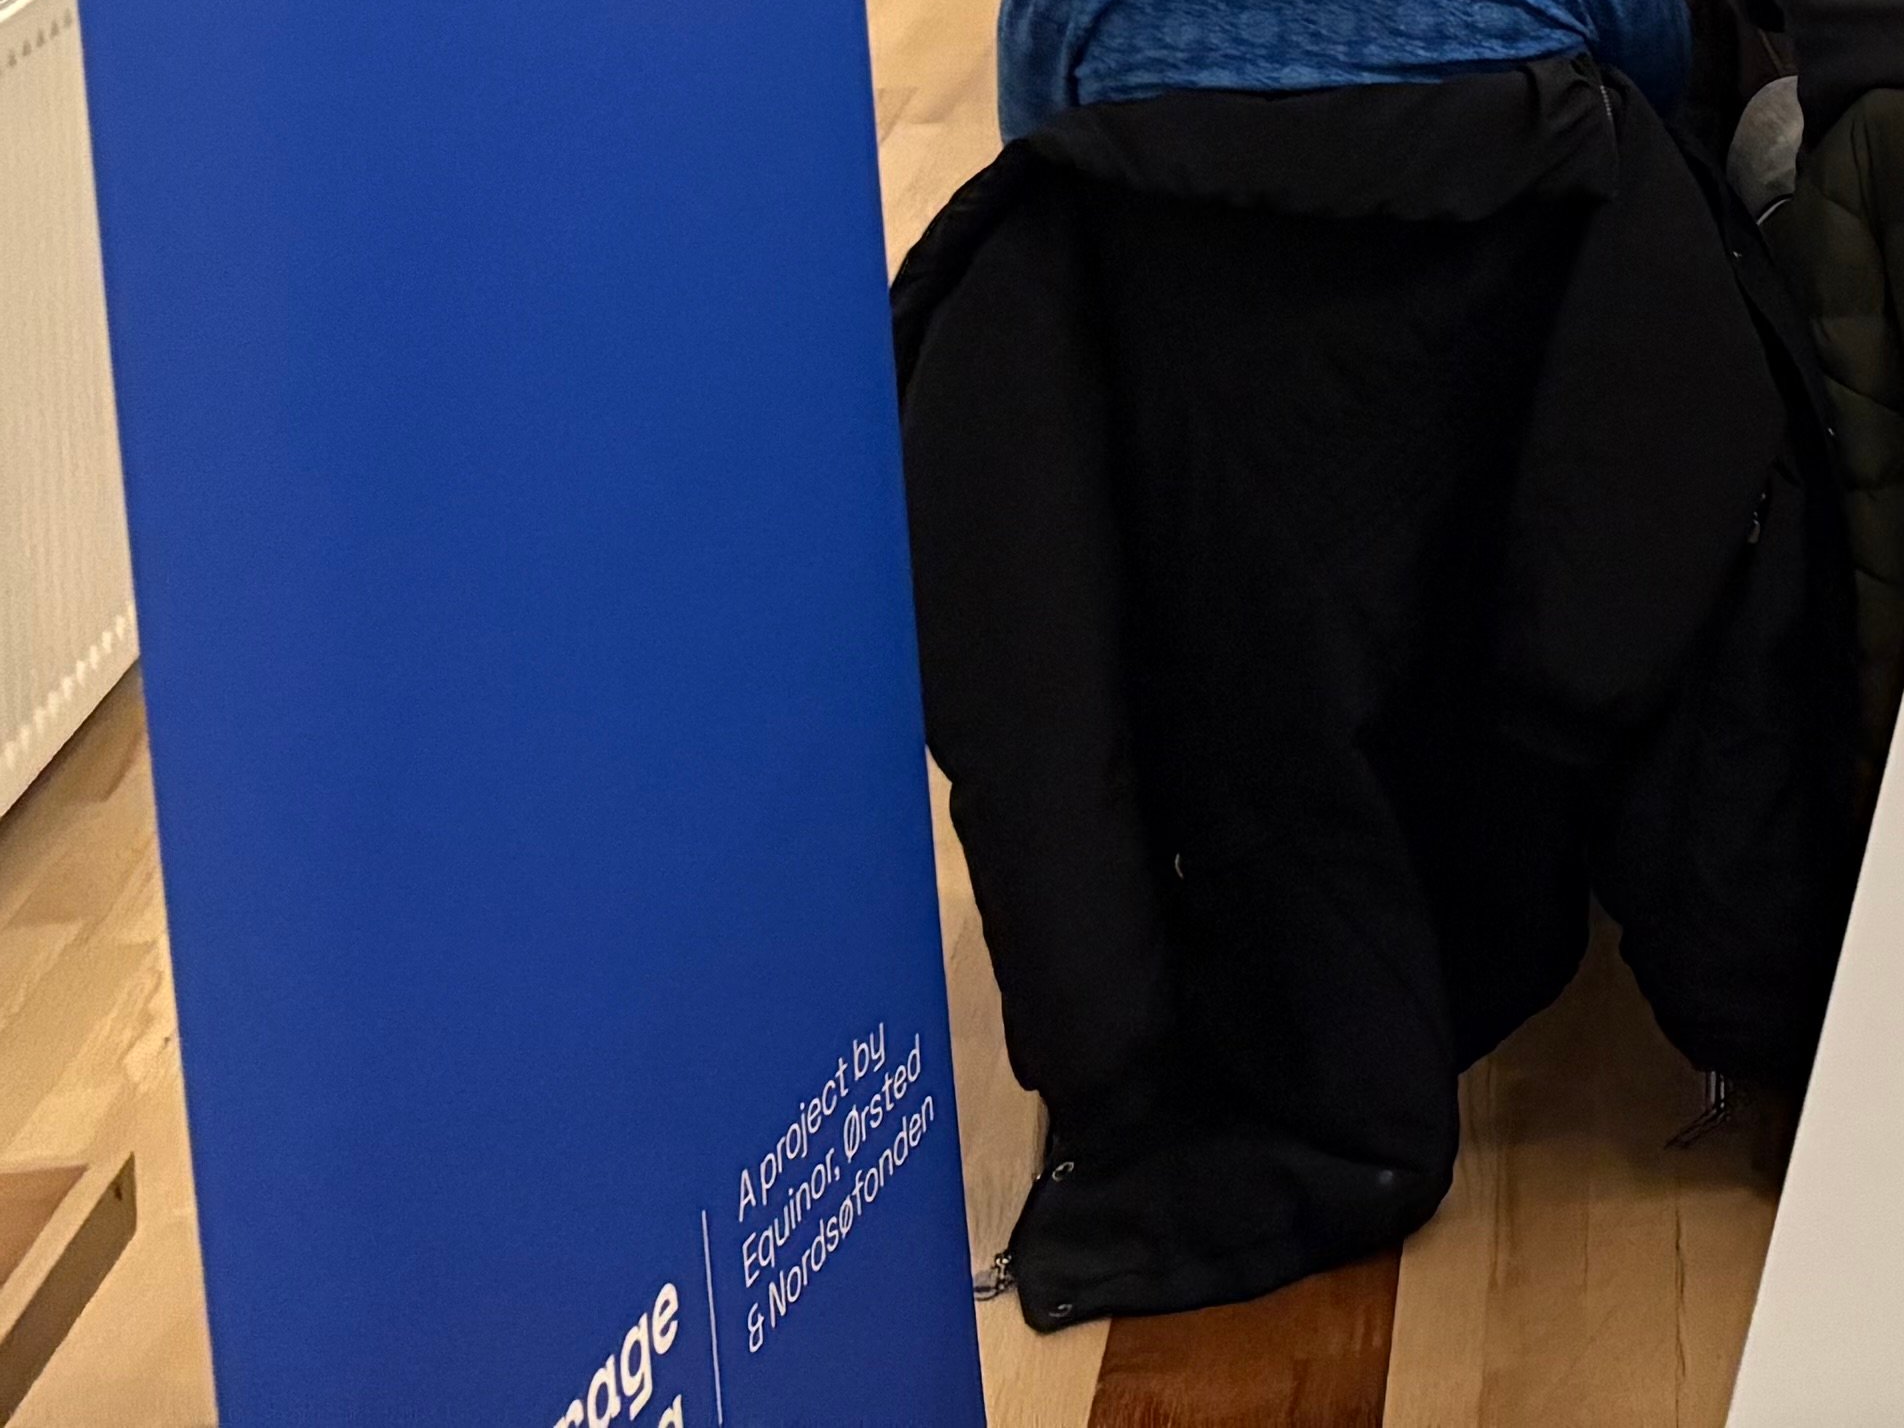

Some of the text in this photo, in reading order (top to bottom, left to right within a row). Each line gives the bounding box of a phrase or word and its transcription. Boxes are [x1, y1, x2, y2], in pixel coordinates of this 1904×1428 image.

[738, 1022, 886, 1223] A project by
[742, 1032, 921, 1288] Equinor, Ørsted
[747, 1095, 934, 1353] & Nordsøfonden
